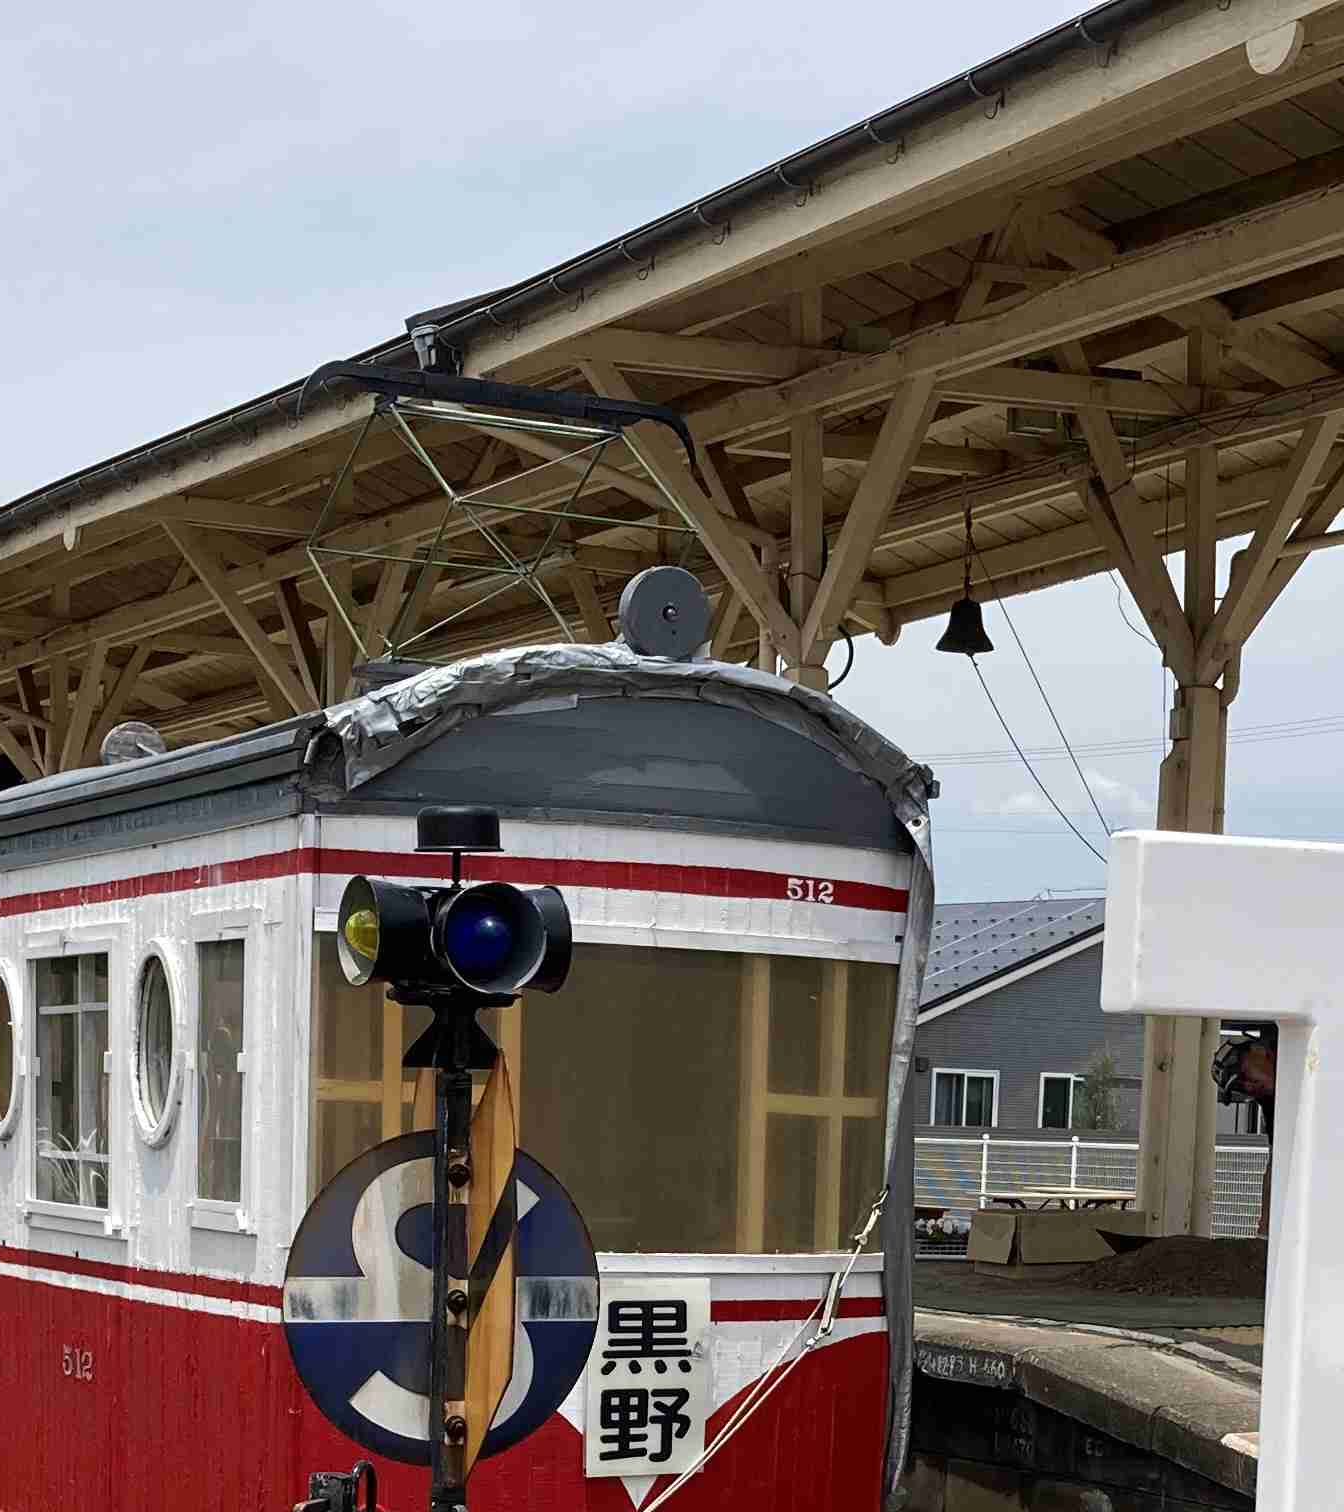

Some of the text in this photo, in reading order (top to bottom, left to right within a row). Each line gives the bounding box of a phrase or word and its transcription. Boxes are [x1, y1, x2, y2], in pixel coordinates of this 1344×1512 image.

[786, 877, 835, 904] 512
[62, 1343, 94, 1382] 512
[599, 1299, 693, 1463] 黒野
